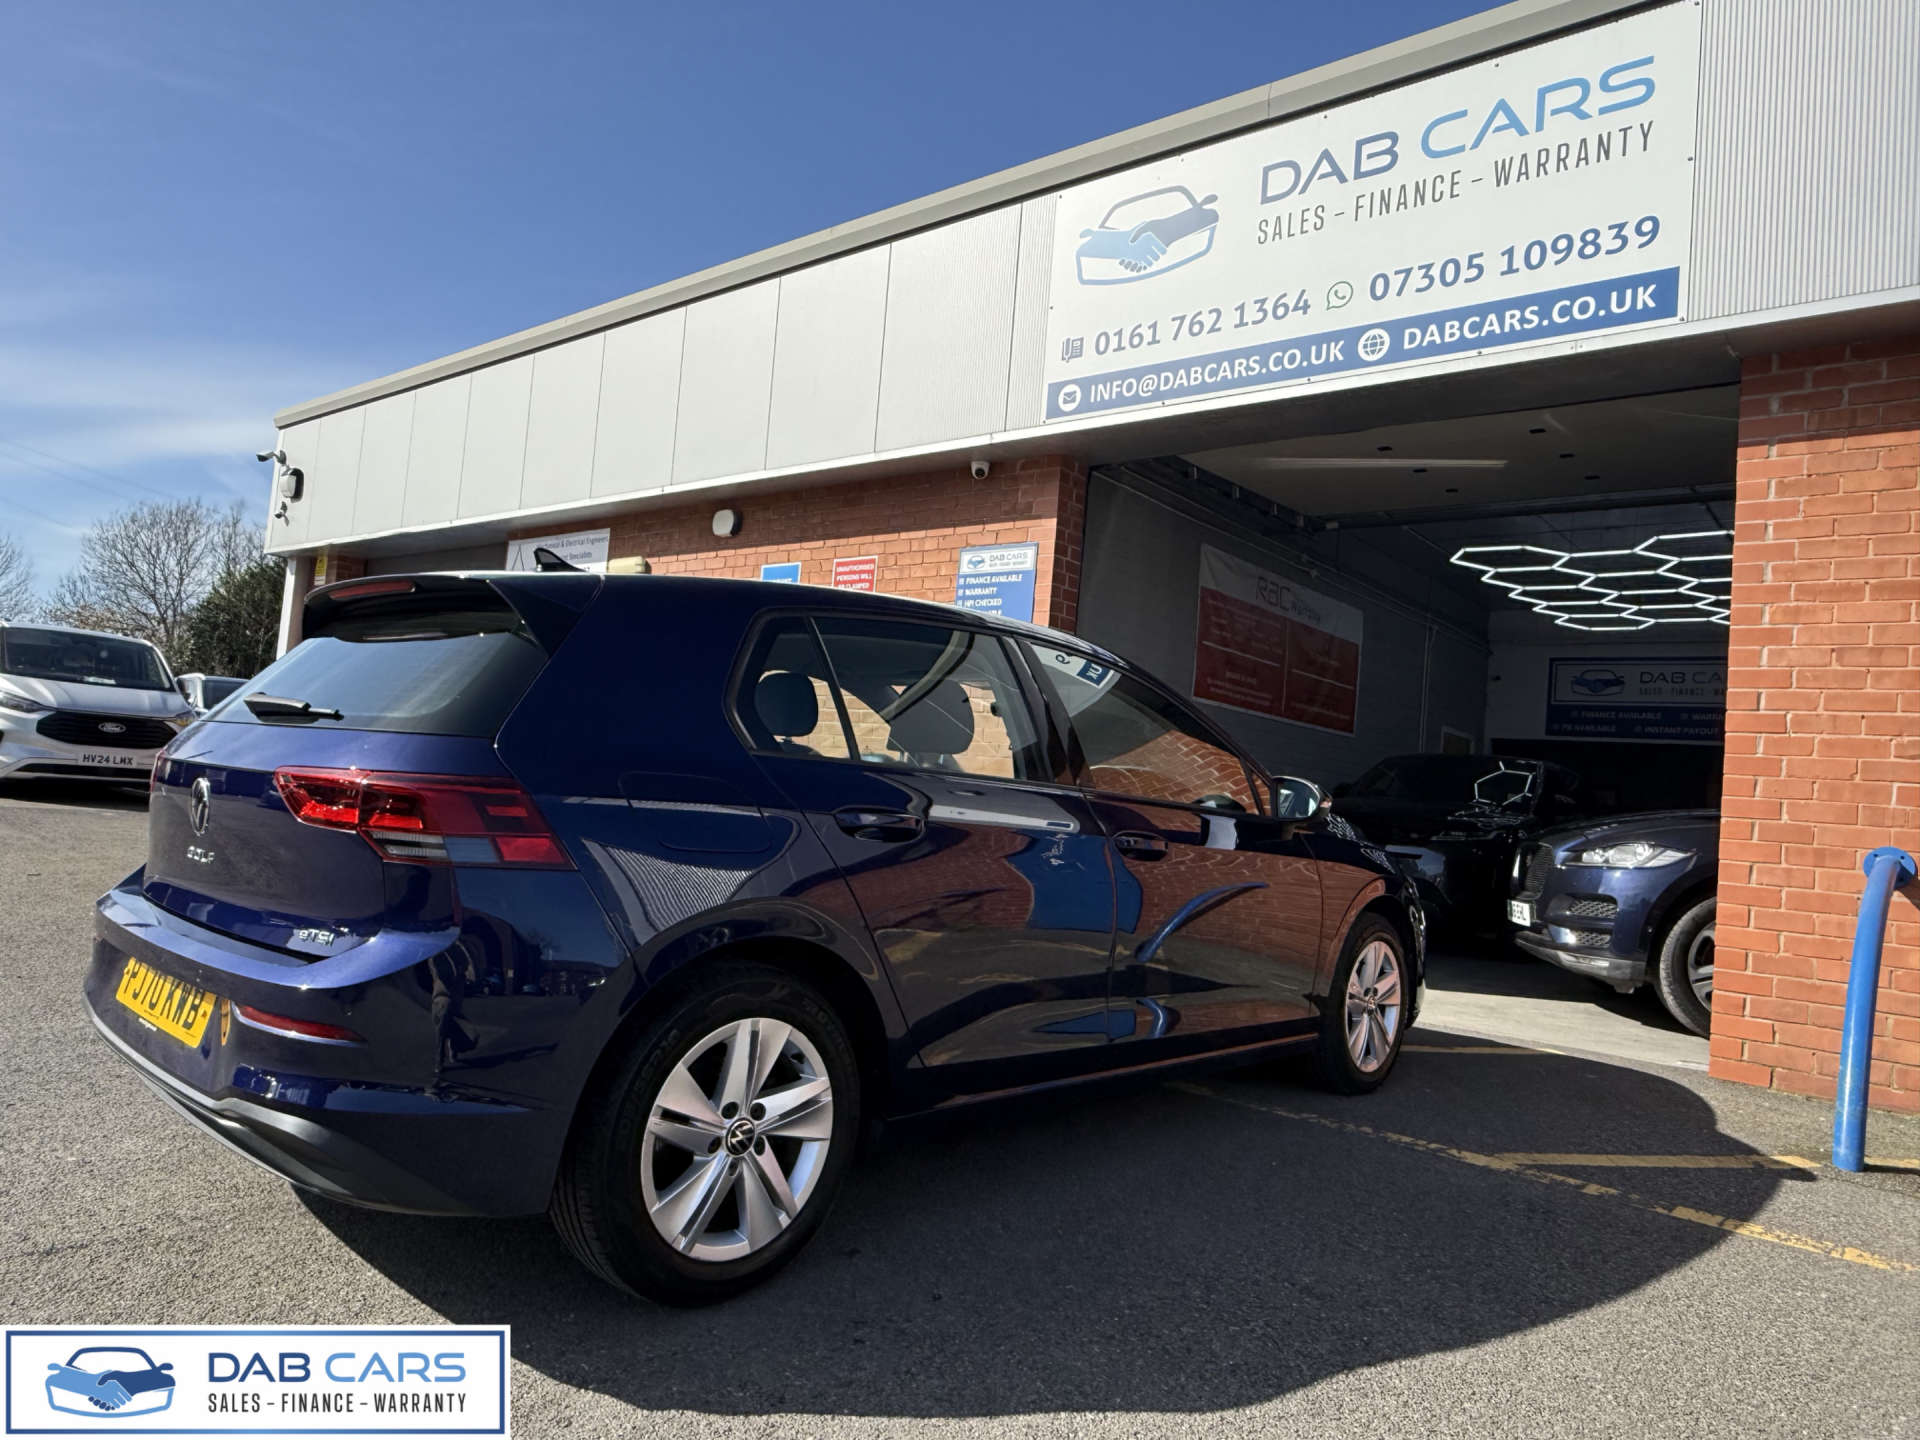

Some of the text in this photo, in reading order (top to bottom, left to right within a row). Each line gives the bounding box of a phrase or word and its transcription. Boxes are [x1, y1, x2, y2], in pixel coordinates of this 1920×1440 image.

[1259, 55, 1656, 206] DAB CARS
[1257, 203, 1326, 245] SALES
[1354, 170, 1462, 223] FINANCE
[1493, 120, 1655, 189] WARRANTY
[1369, 215, 1661, 302] 07305 109839
[1093, 289, 1311, 357] 0161 762 1364
[1402, 283, 1657, 352] DABCARS.CO.UK
[1089, 340, 1345, 404] INFO@DABCARS.CO.UK
[966, 574, 1022, 584] FINANCE AVAILABLE
[989, 552, 1028, 562] DAB CARS
[965, 587, 997, 596] WARRANTY
[1640, 671, 1722, 684] DAB CA
[83, 754, 110, 764] HV24
